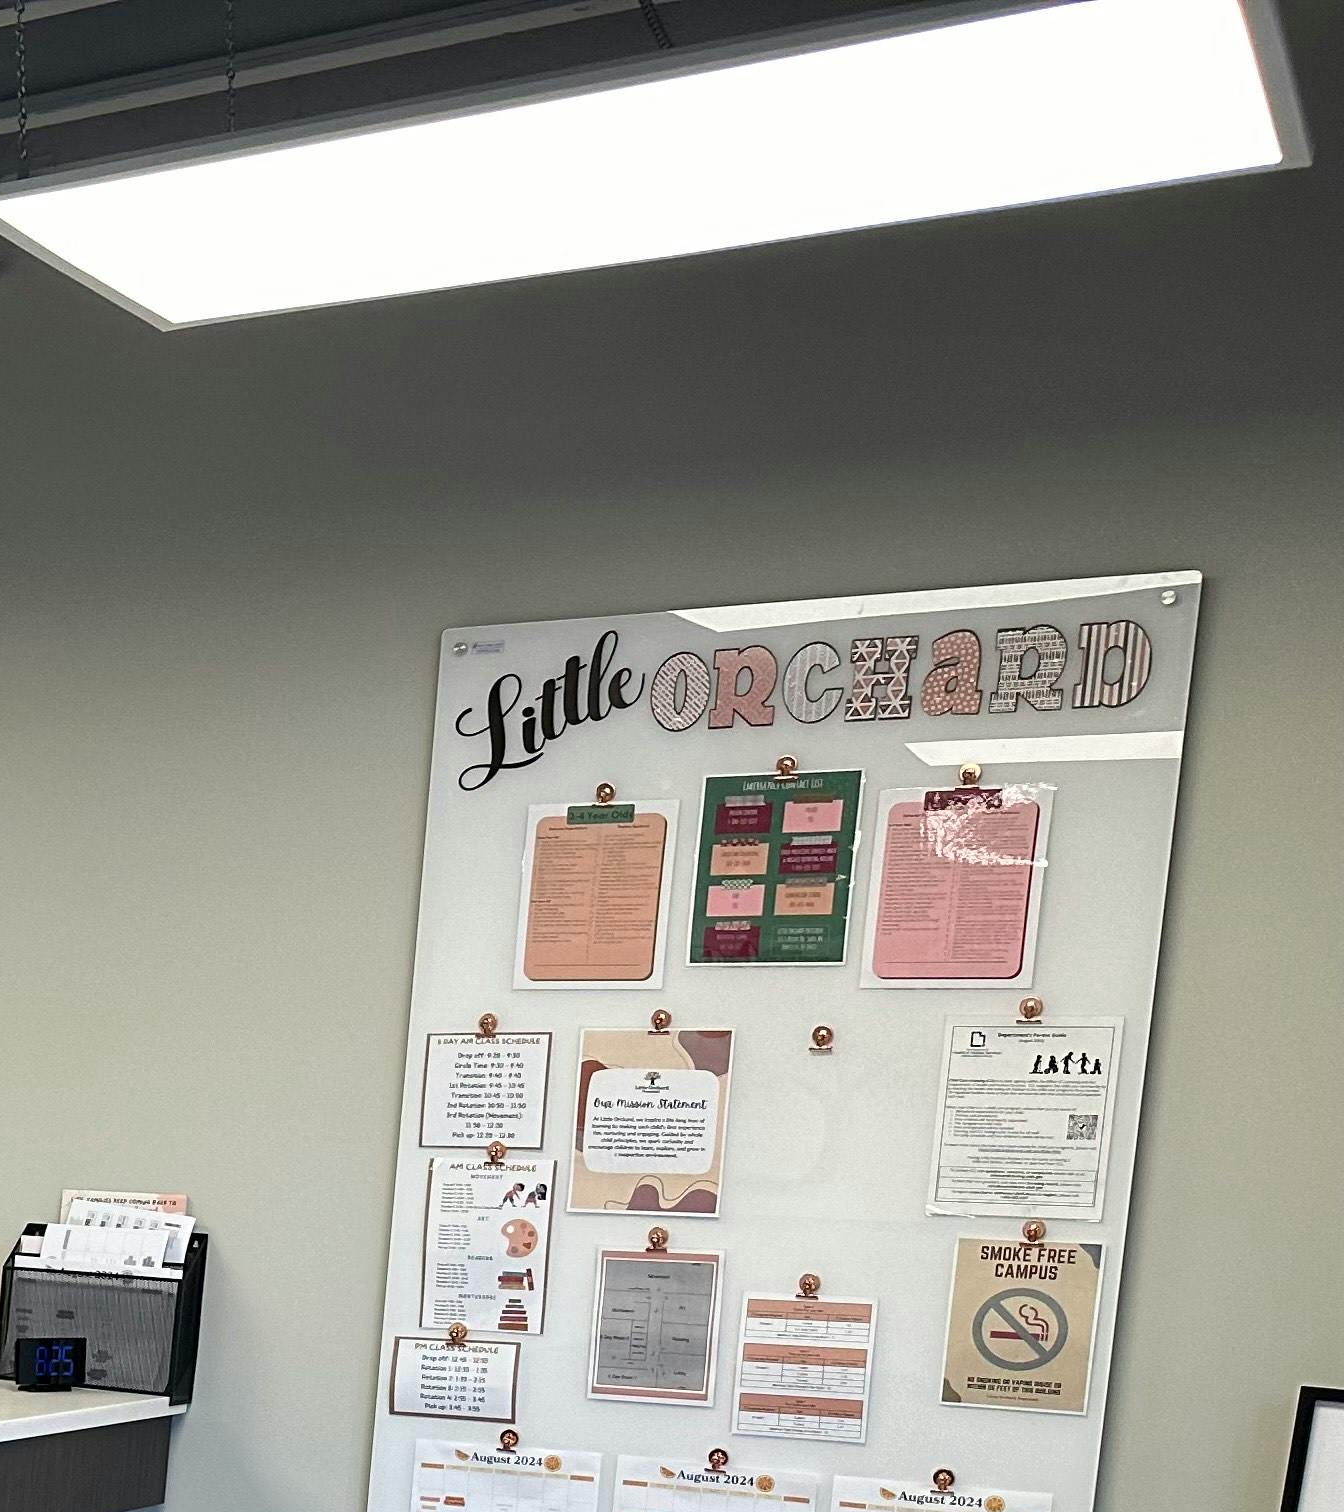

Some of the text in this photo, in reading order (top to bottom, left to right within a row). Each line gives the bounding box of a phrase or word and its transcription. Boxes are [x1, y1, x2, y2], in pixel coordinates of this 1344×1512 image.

[457, 630, 646, 792] Little
[593, 1098, 707, 1110] Our Mission Statement
[495, 1164, 537, 1172] SCHEDULE
[980, 1245, 1078, 1264] SMOKE FREE
[994, 1263, 1058, 1280] CAMPUS
[429, 1343, 455, 1351] CLASS
[458, 1345, 499, 1354] SCHEDULE
[470, 1452, 543, 1467] August 2024
[677, 1470, 754, 1486] August 2024
[897, 1490, 982, 1508] August 2024
